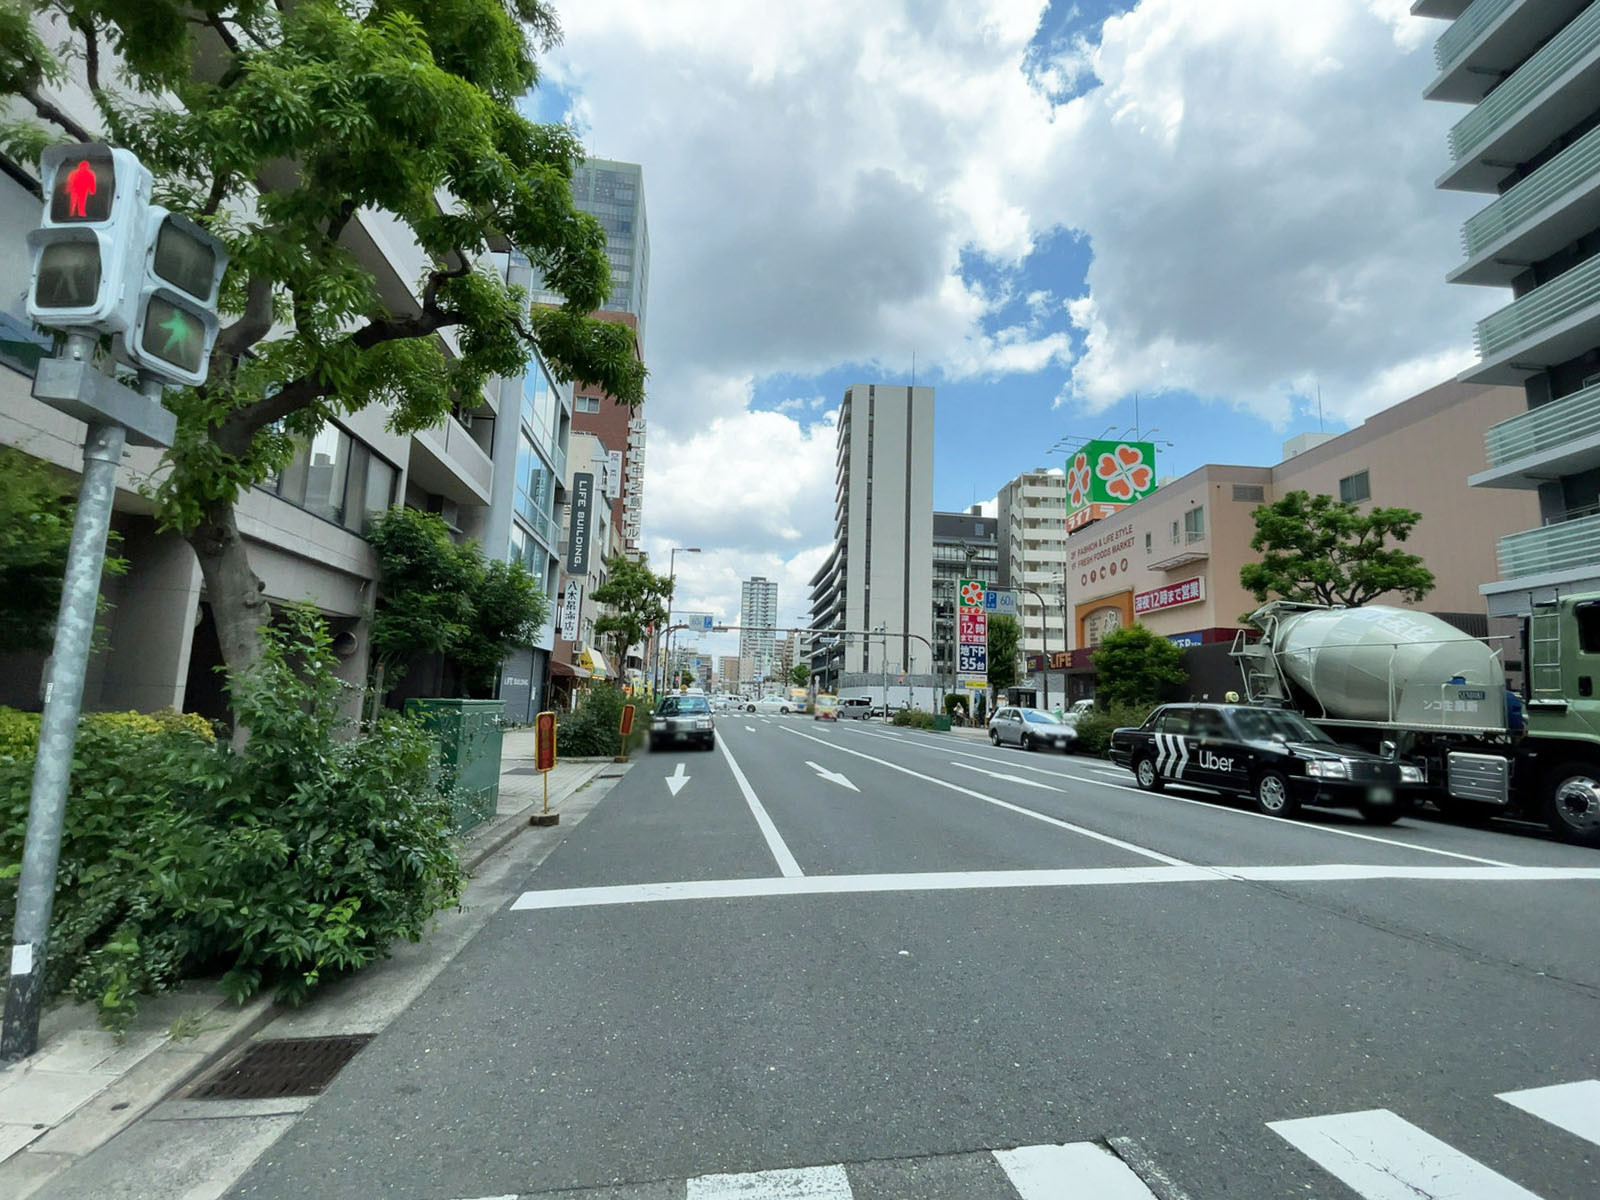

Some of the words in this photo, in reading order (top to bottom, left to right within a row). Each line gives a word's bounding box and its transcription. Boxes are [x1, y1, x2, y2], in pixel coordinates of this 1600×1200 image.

[577, 480, 588, 508] LIFE
[1068, 508, 1091, 530] ライフ
[1077, 541, 1098, 557] FASHION
[1103, 532, 1114, 546] LIFE
[1115, 524, 1133, 540] STYLE
[1077, 556, 1093, 569] FRESH
[1093, 547, 1111, 561] FOODS
[1111, 537, 1135, 554] MARKET
[1135, 581, 1200, 611] 深夜12時まで営業
[960, 646, 985, 657] 地下P
[1050, 652, 1072, 669] LIFE
[961, 657, 985, 671] 35台
[1199, 750, 1235, 772] Uber
